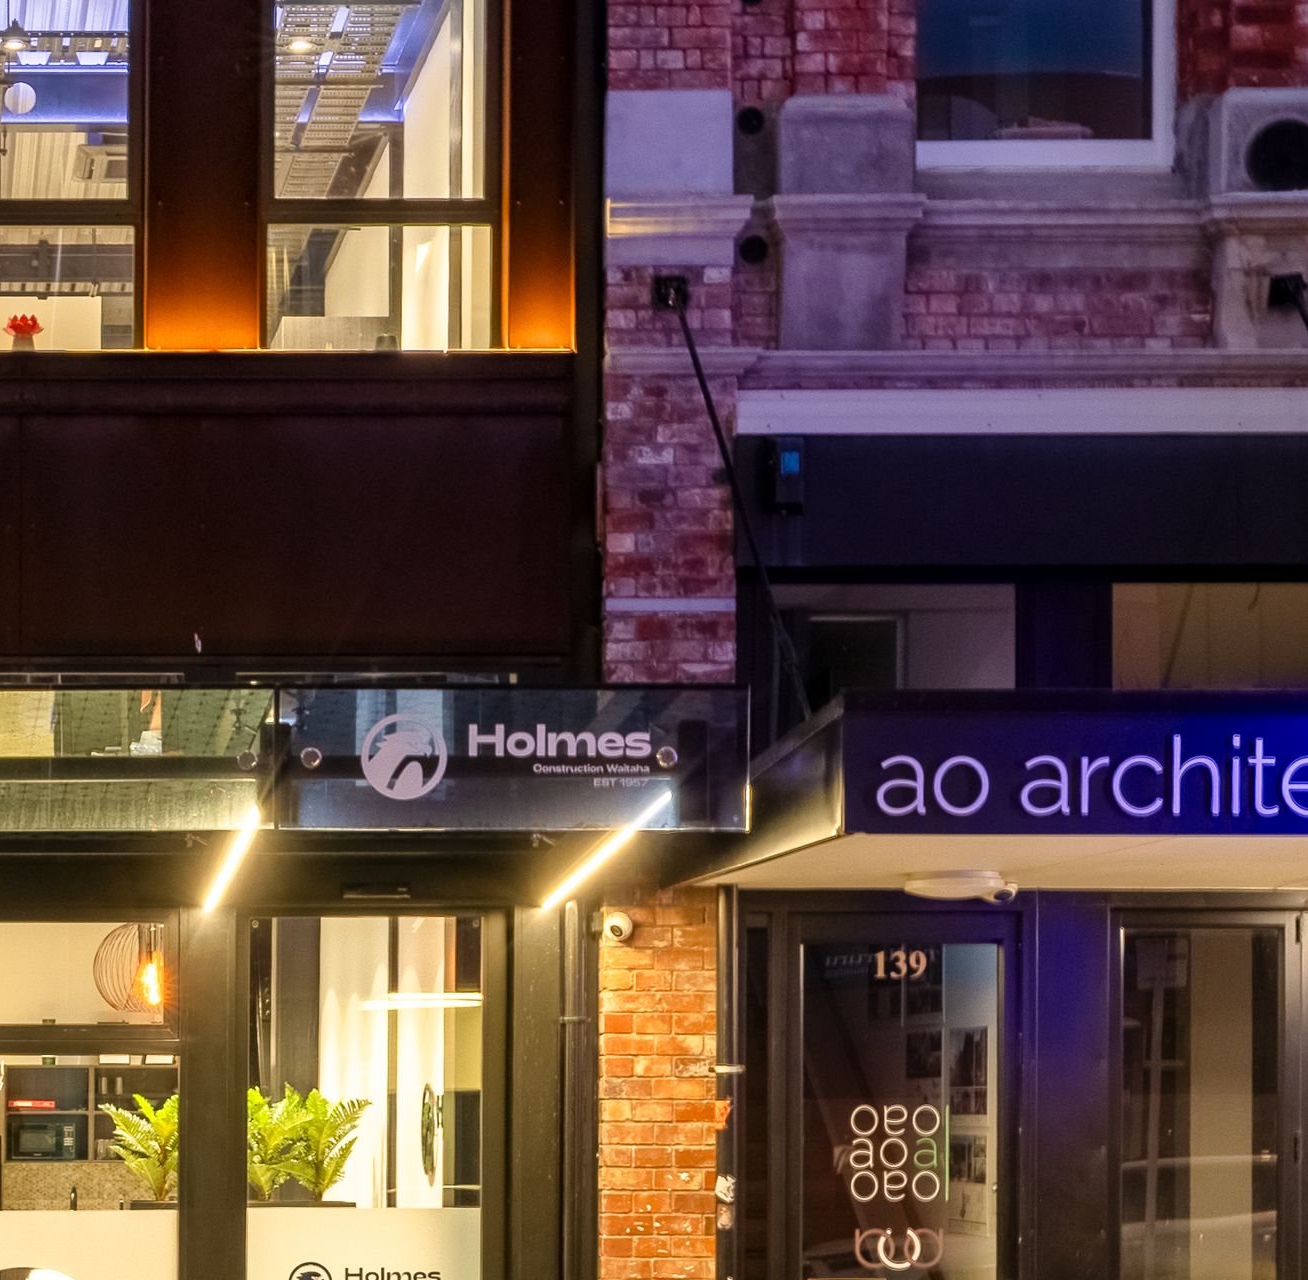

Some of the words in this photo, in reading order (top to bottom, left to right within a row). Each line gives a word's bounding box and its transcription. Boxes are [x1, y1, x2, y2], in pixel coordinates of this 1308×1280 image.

[468, 723, 652, 759] Holmes
[532, 763, 604, 775] Construction
[606, 763, 650, 774] Waitaha
[594, 777, 615, 787] EST
[876, 755, 990, 816] ao
[874, 950, 927, 979] 139
